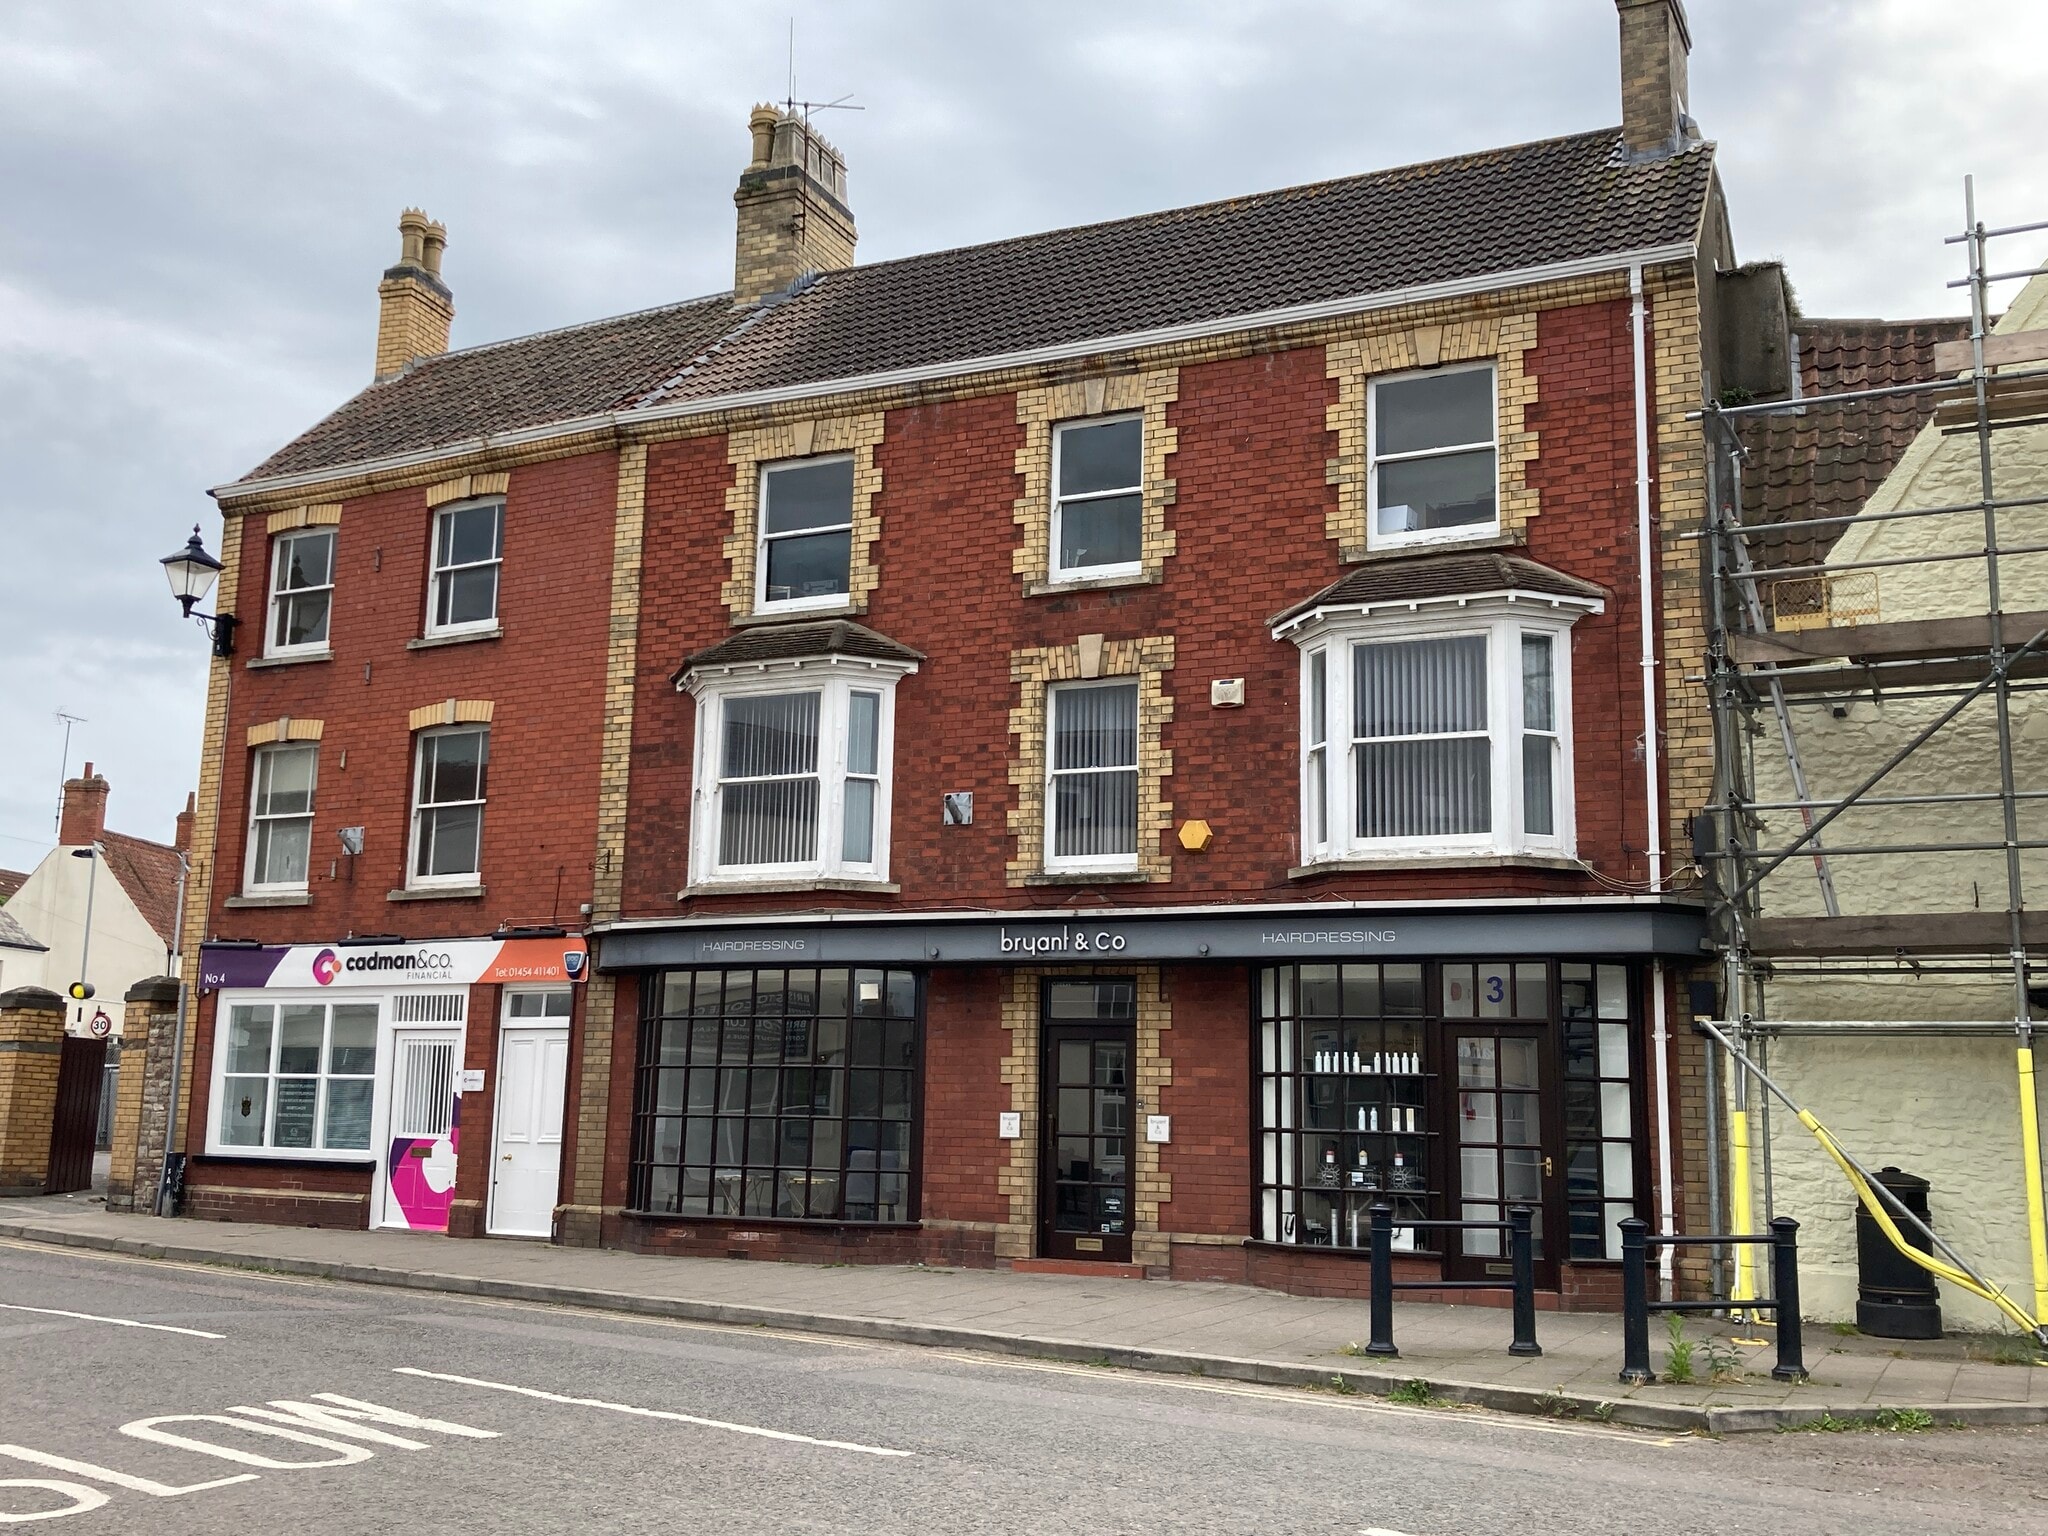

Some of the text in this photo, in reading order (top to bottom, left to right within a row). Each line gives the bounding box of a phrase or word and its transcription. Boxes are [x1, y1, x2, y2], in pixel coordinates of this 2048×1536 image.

[1000, 925, 1126, 956] bryant & Co
[1262, 930, 1396, 944] HAIRDRESSING
[702, 939, 805, 952] HAIRDRESSING
[406, 971, 453, 980] FINANCIAL
[509, 966, 532, 977] 01454
[534, 966, 560, 976] 411401
[205, 973, 226, 984] No 4
[1486, 976, 1504, 1003] 3
[93, 1020, 107, 1030] 30
